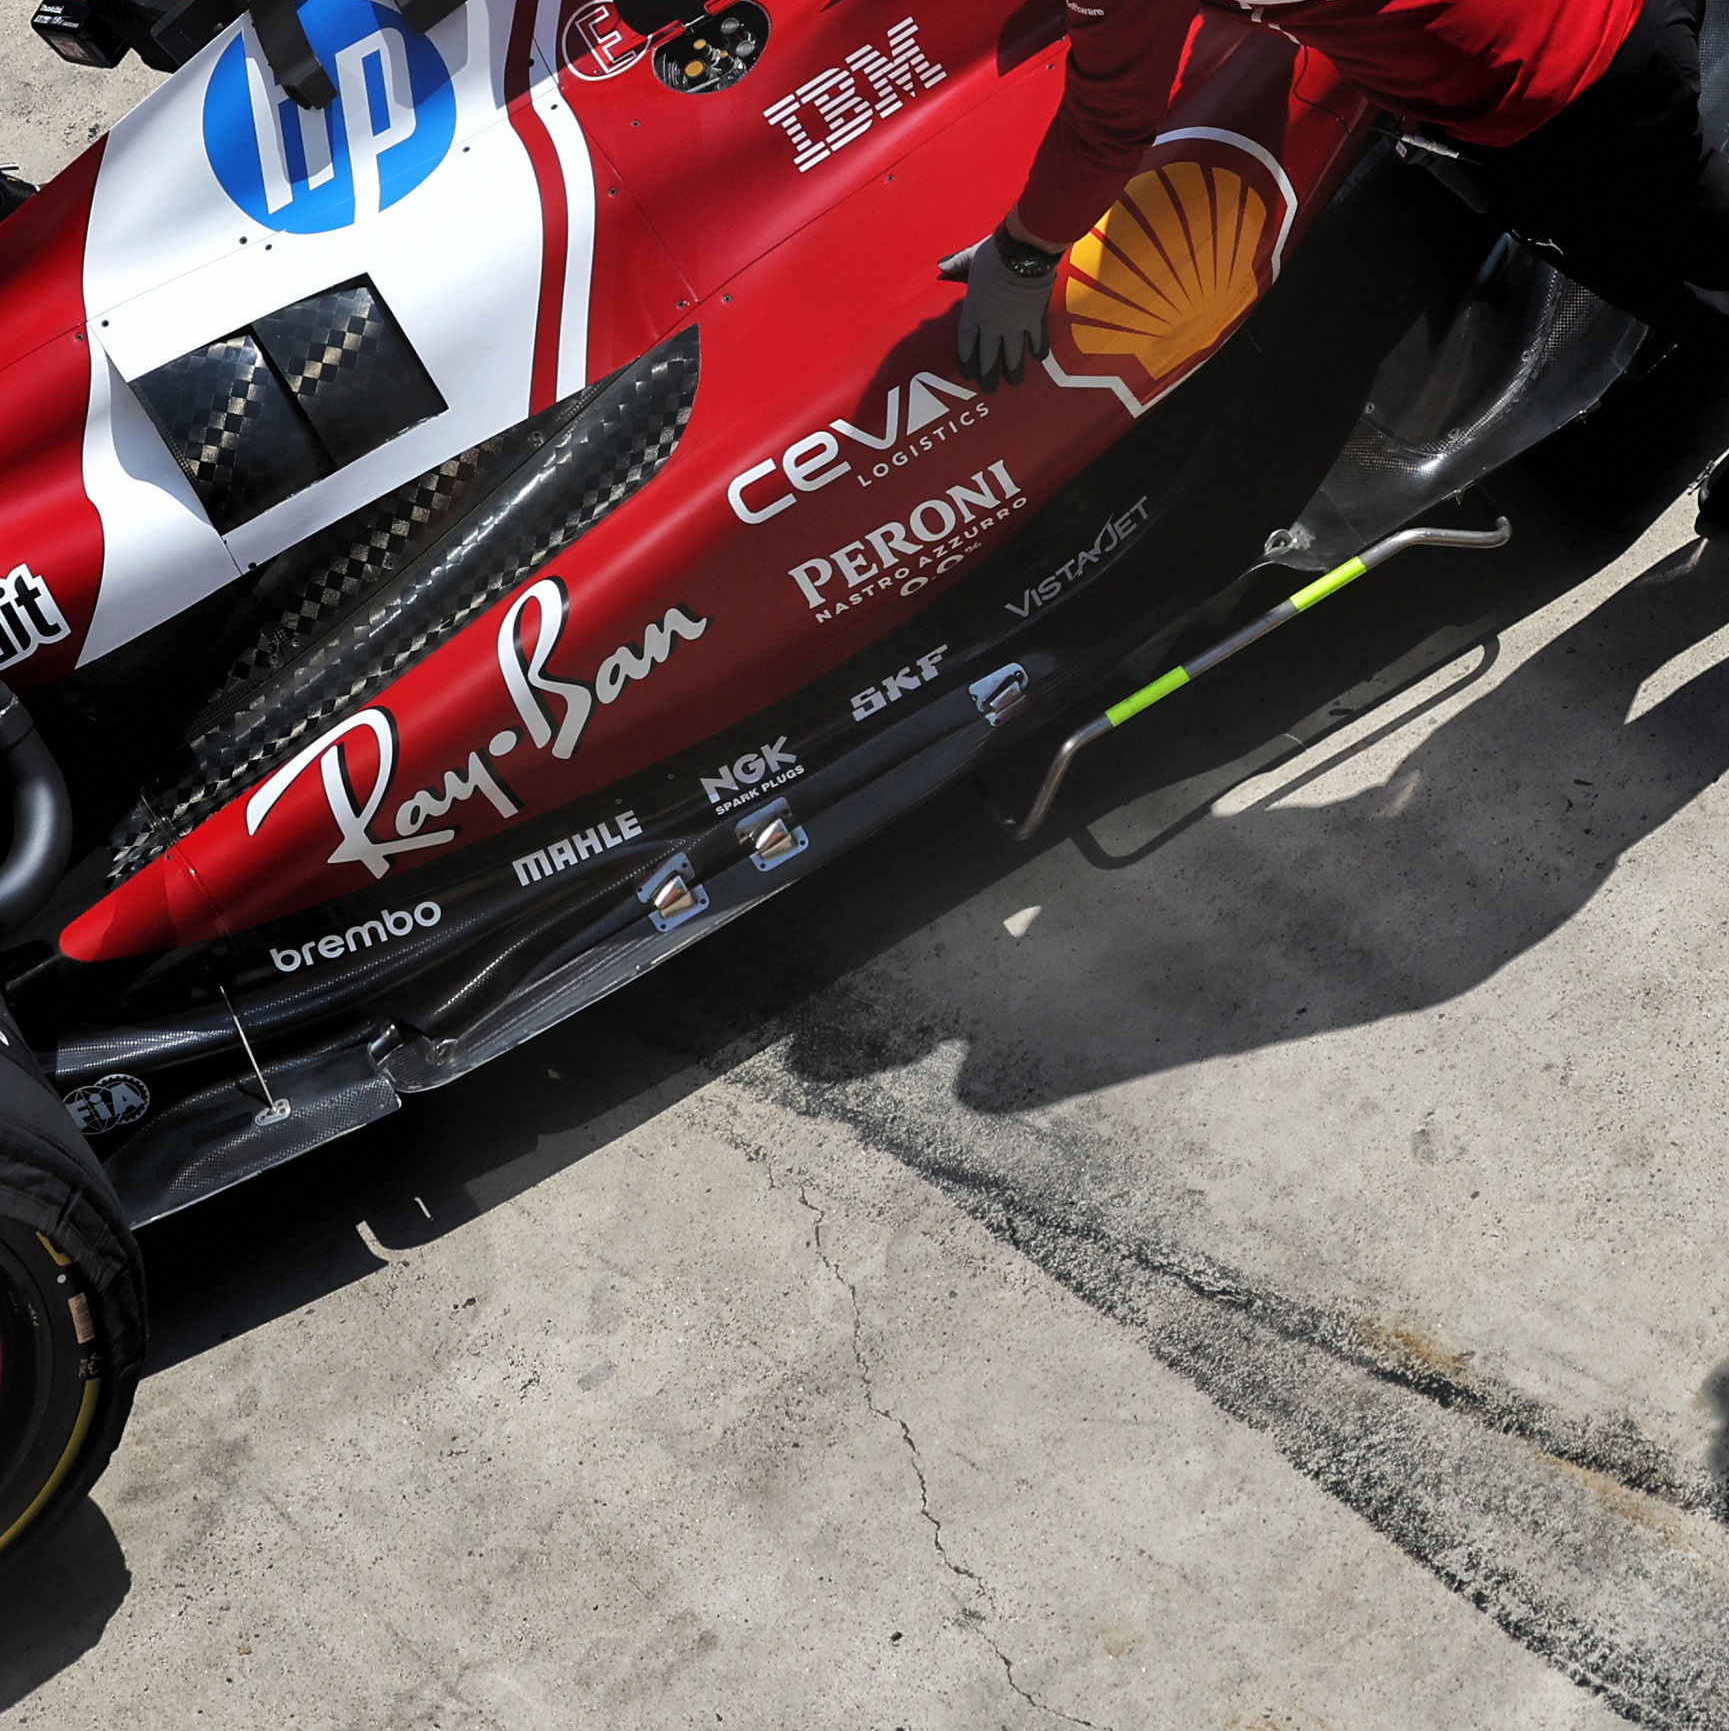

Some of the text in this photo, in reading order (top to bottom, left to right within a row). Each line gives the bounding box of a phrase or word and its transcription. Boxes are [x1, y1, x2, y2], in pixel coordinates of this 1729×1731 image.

[762, 15, 947, 171] IBM
[856, 400, 992, 489] LOGISTICS
[787, 458, 1022, 610] PERONI
[815, 496, 1029, 624] NASTRO AZZURRO
[851, 643, 951, 723] SKF
[698, 735, 799, 805] NGK
[715, 763, 806, 817] SPARK PLUGS
[511, 809, 645, 887] MAHLE
[271, 899, 443, 974] brembo
